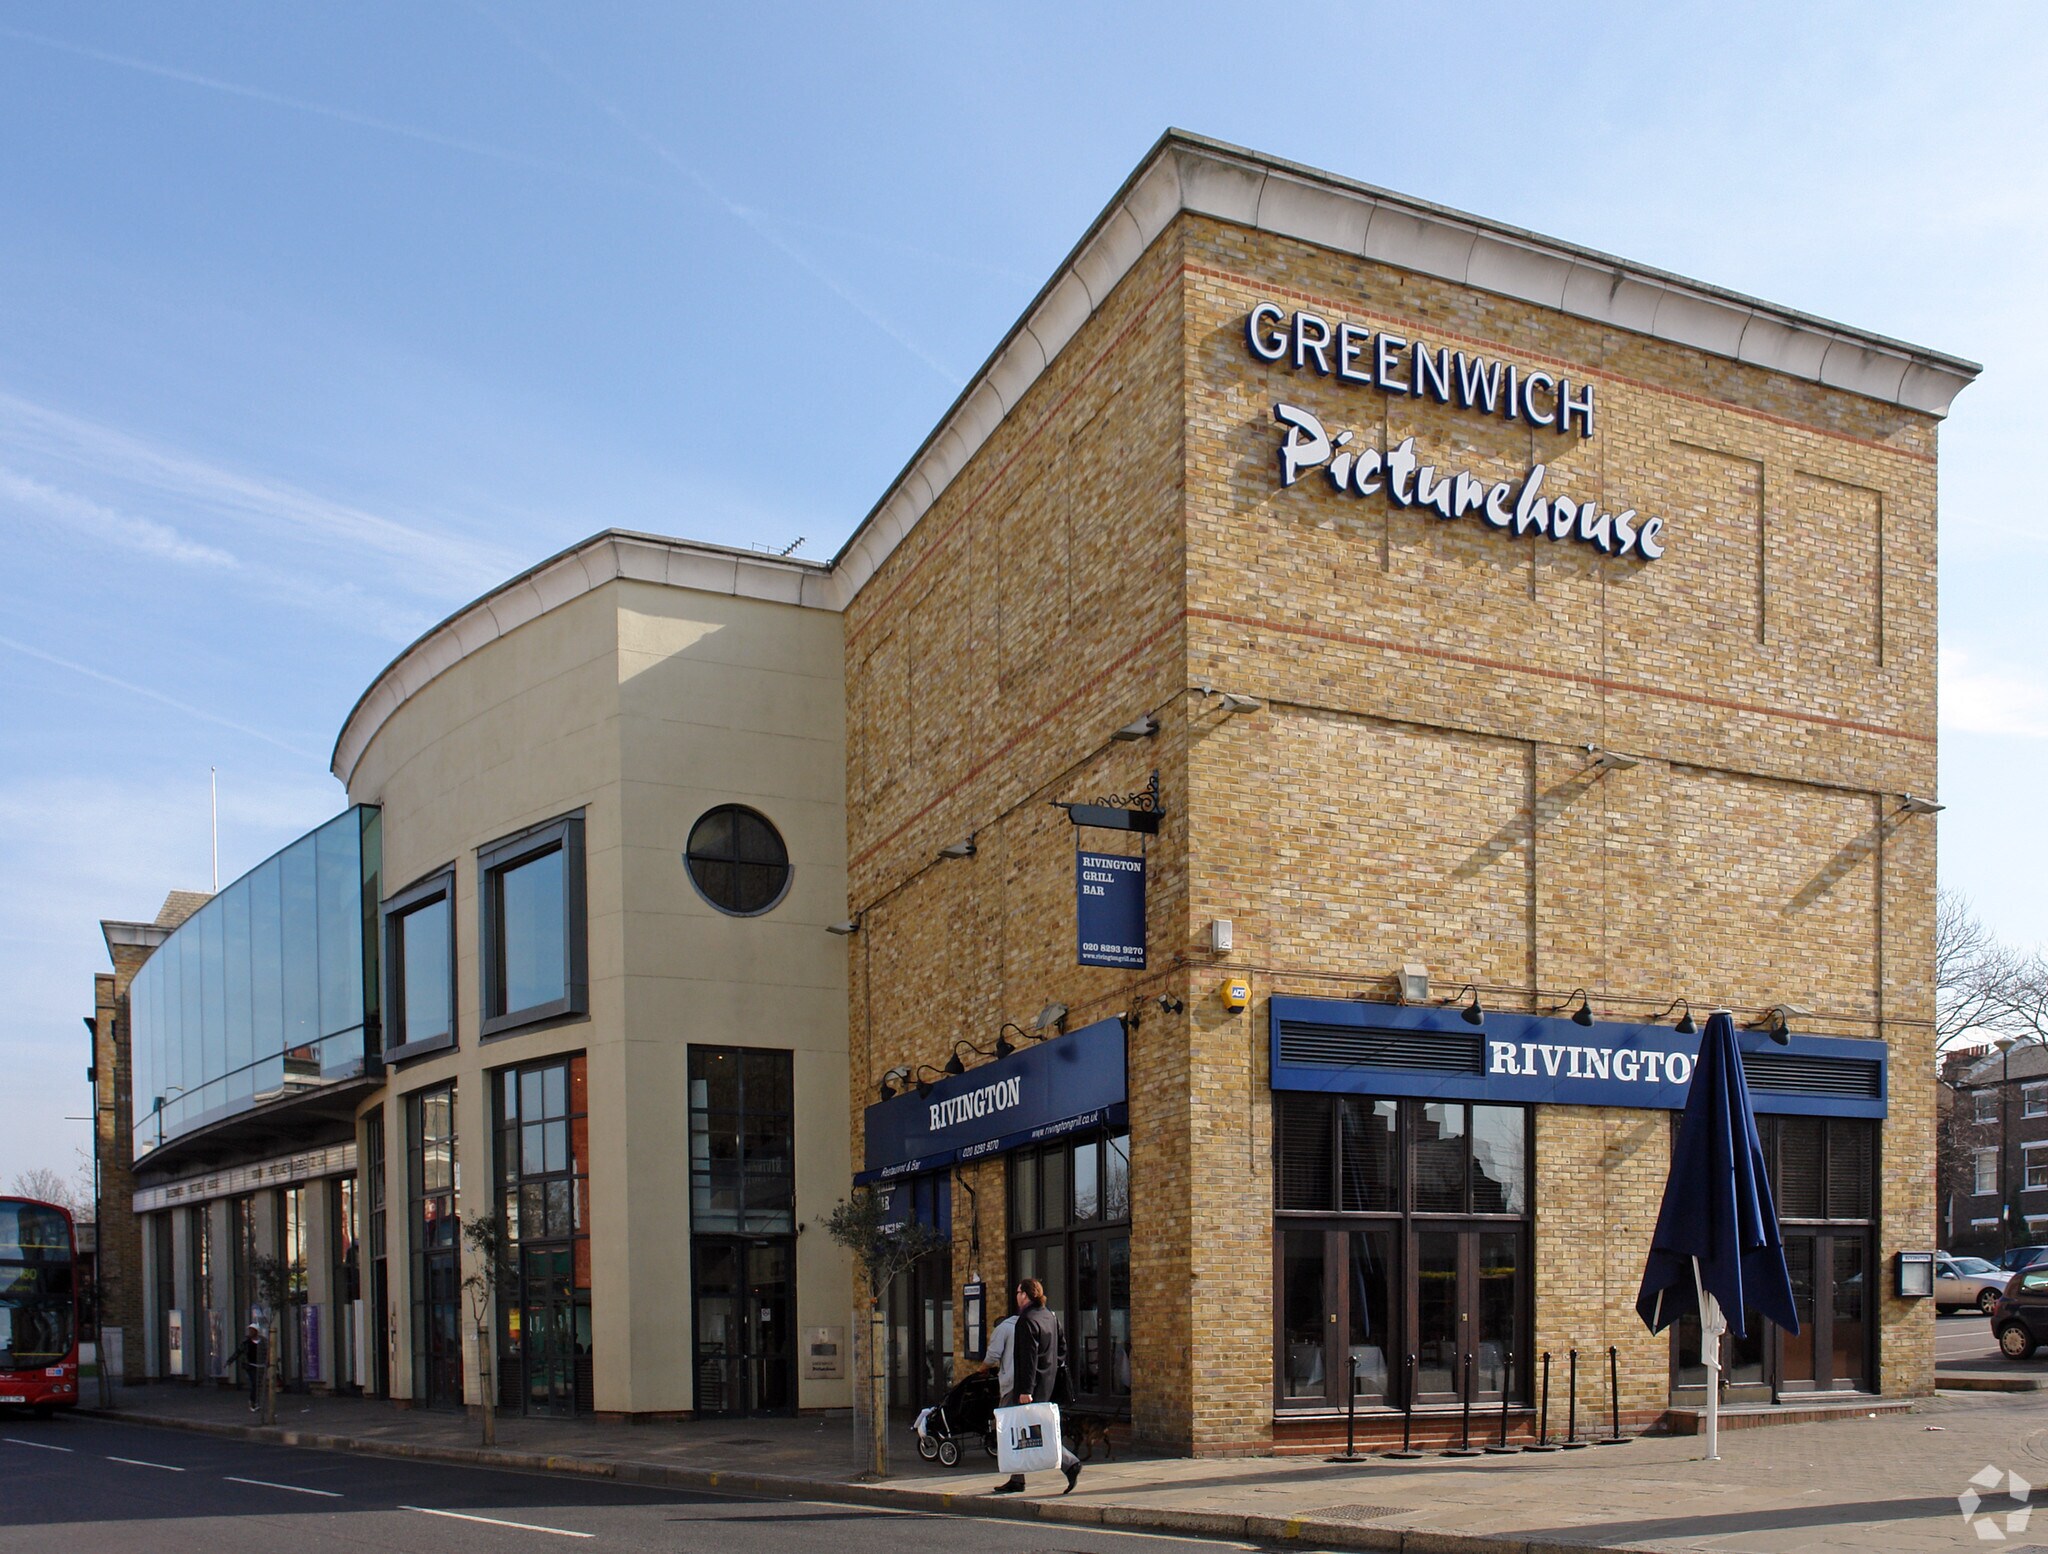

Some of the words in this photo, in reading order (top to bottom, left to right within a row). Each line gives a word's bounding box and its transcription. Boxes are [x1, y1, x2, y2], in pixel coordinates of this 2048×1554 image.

[1246, 302, 1594, 438] GREENWICH
[1273, 403, 1666, 561] Picturehouse
[1083, 857, 1141, 872] RIVINGTON
[1083, 871, 1114, 883] GRILL
[1083, 885, 1105, 896] BAR
[1083, 943, 1099, 951] 020
[1100, 944, 1120, 953] 8293
[1122, 945, 1144, 955] 9270
[1083, 953, 1144, 963] www.rivingtongrill.co.uk
[1489, 1041, 1698, 1084] RIVINGTO
[930, 1076, 1020, 1131] RIVINGTON
[911, 1159, 921, 1171] Bar
